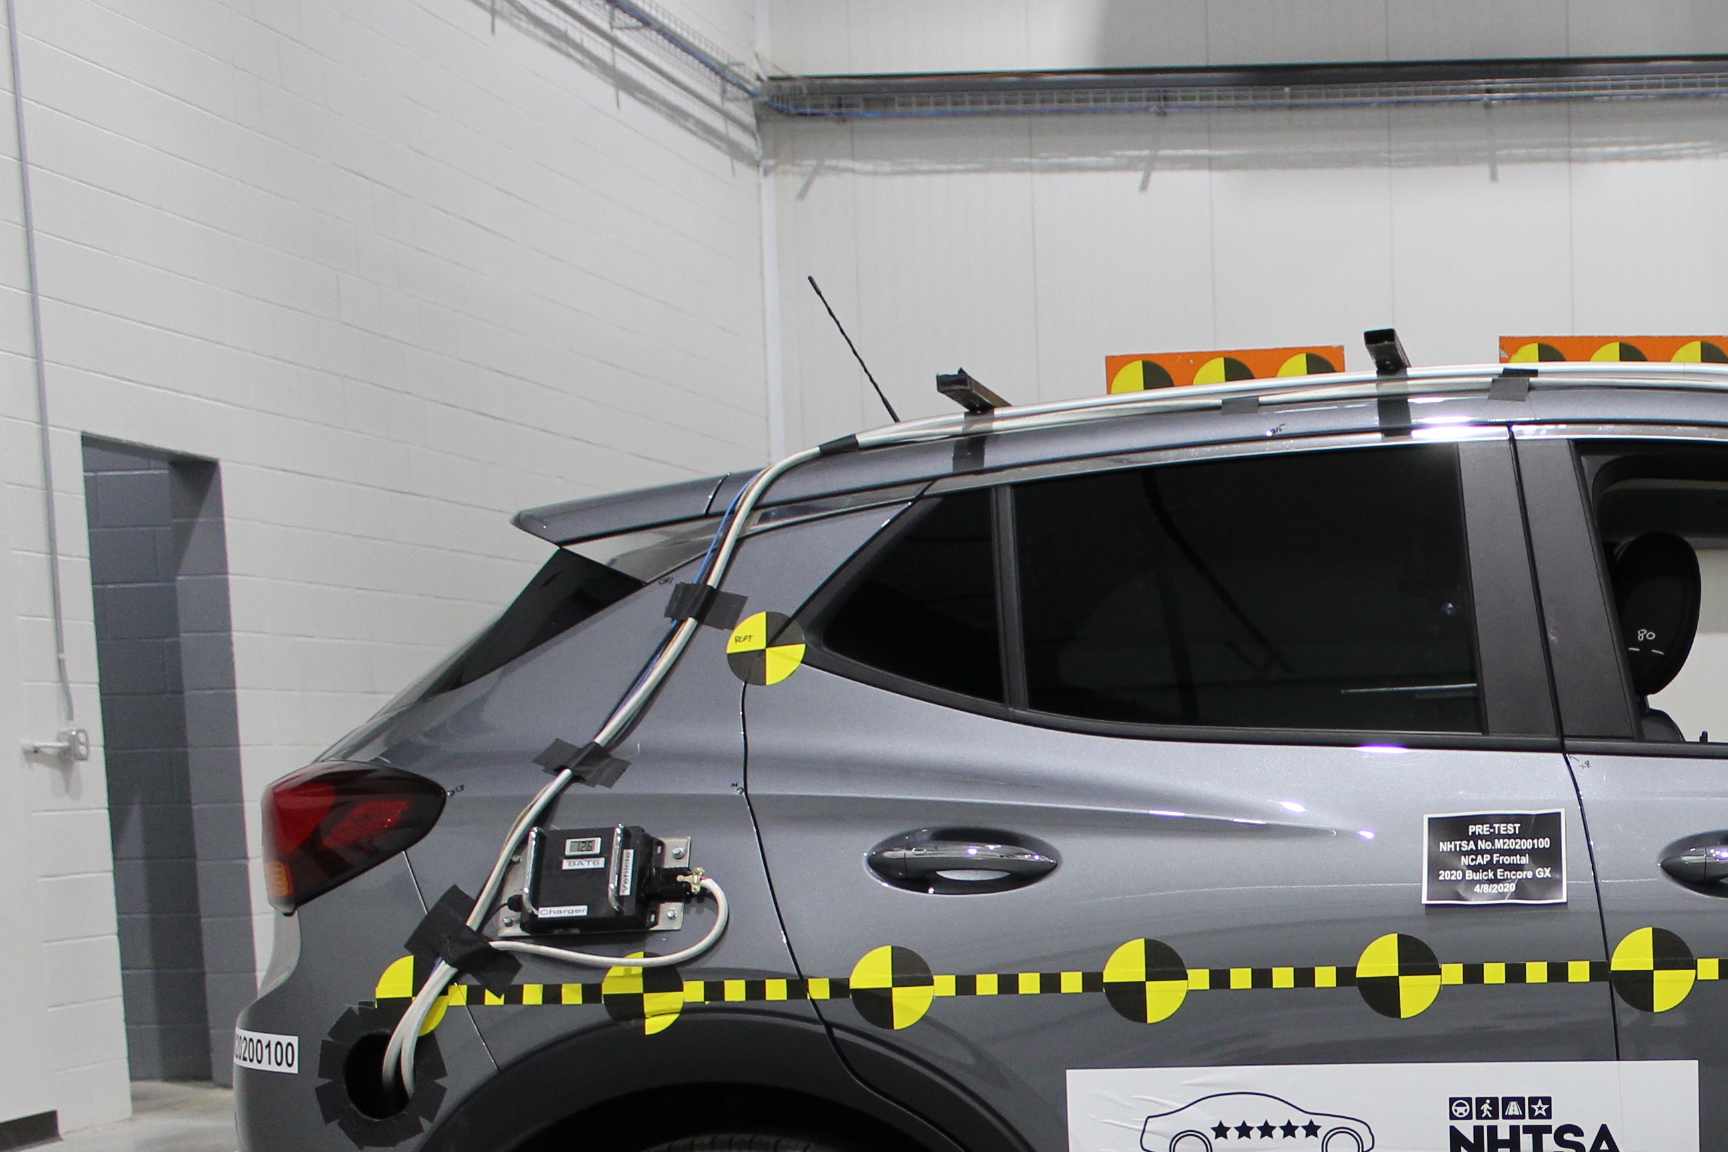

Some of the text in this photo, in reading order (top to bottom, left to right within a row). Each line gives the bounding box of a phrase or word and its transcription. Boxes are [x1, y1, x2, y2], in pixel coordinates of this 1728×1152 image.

[1468, 823, 1521, 836] PRE-TEST
[1439, 837, 1550, 852] NHTSA No.M20200100
[1460, 853, 1529, 866] NCAP Frontal
[1438, 867, 1552, 881] 2020 Buick Encore GX
[1473, 882, 1516, 894] 4/8/2020
